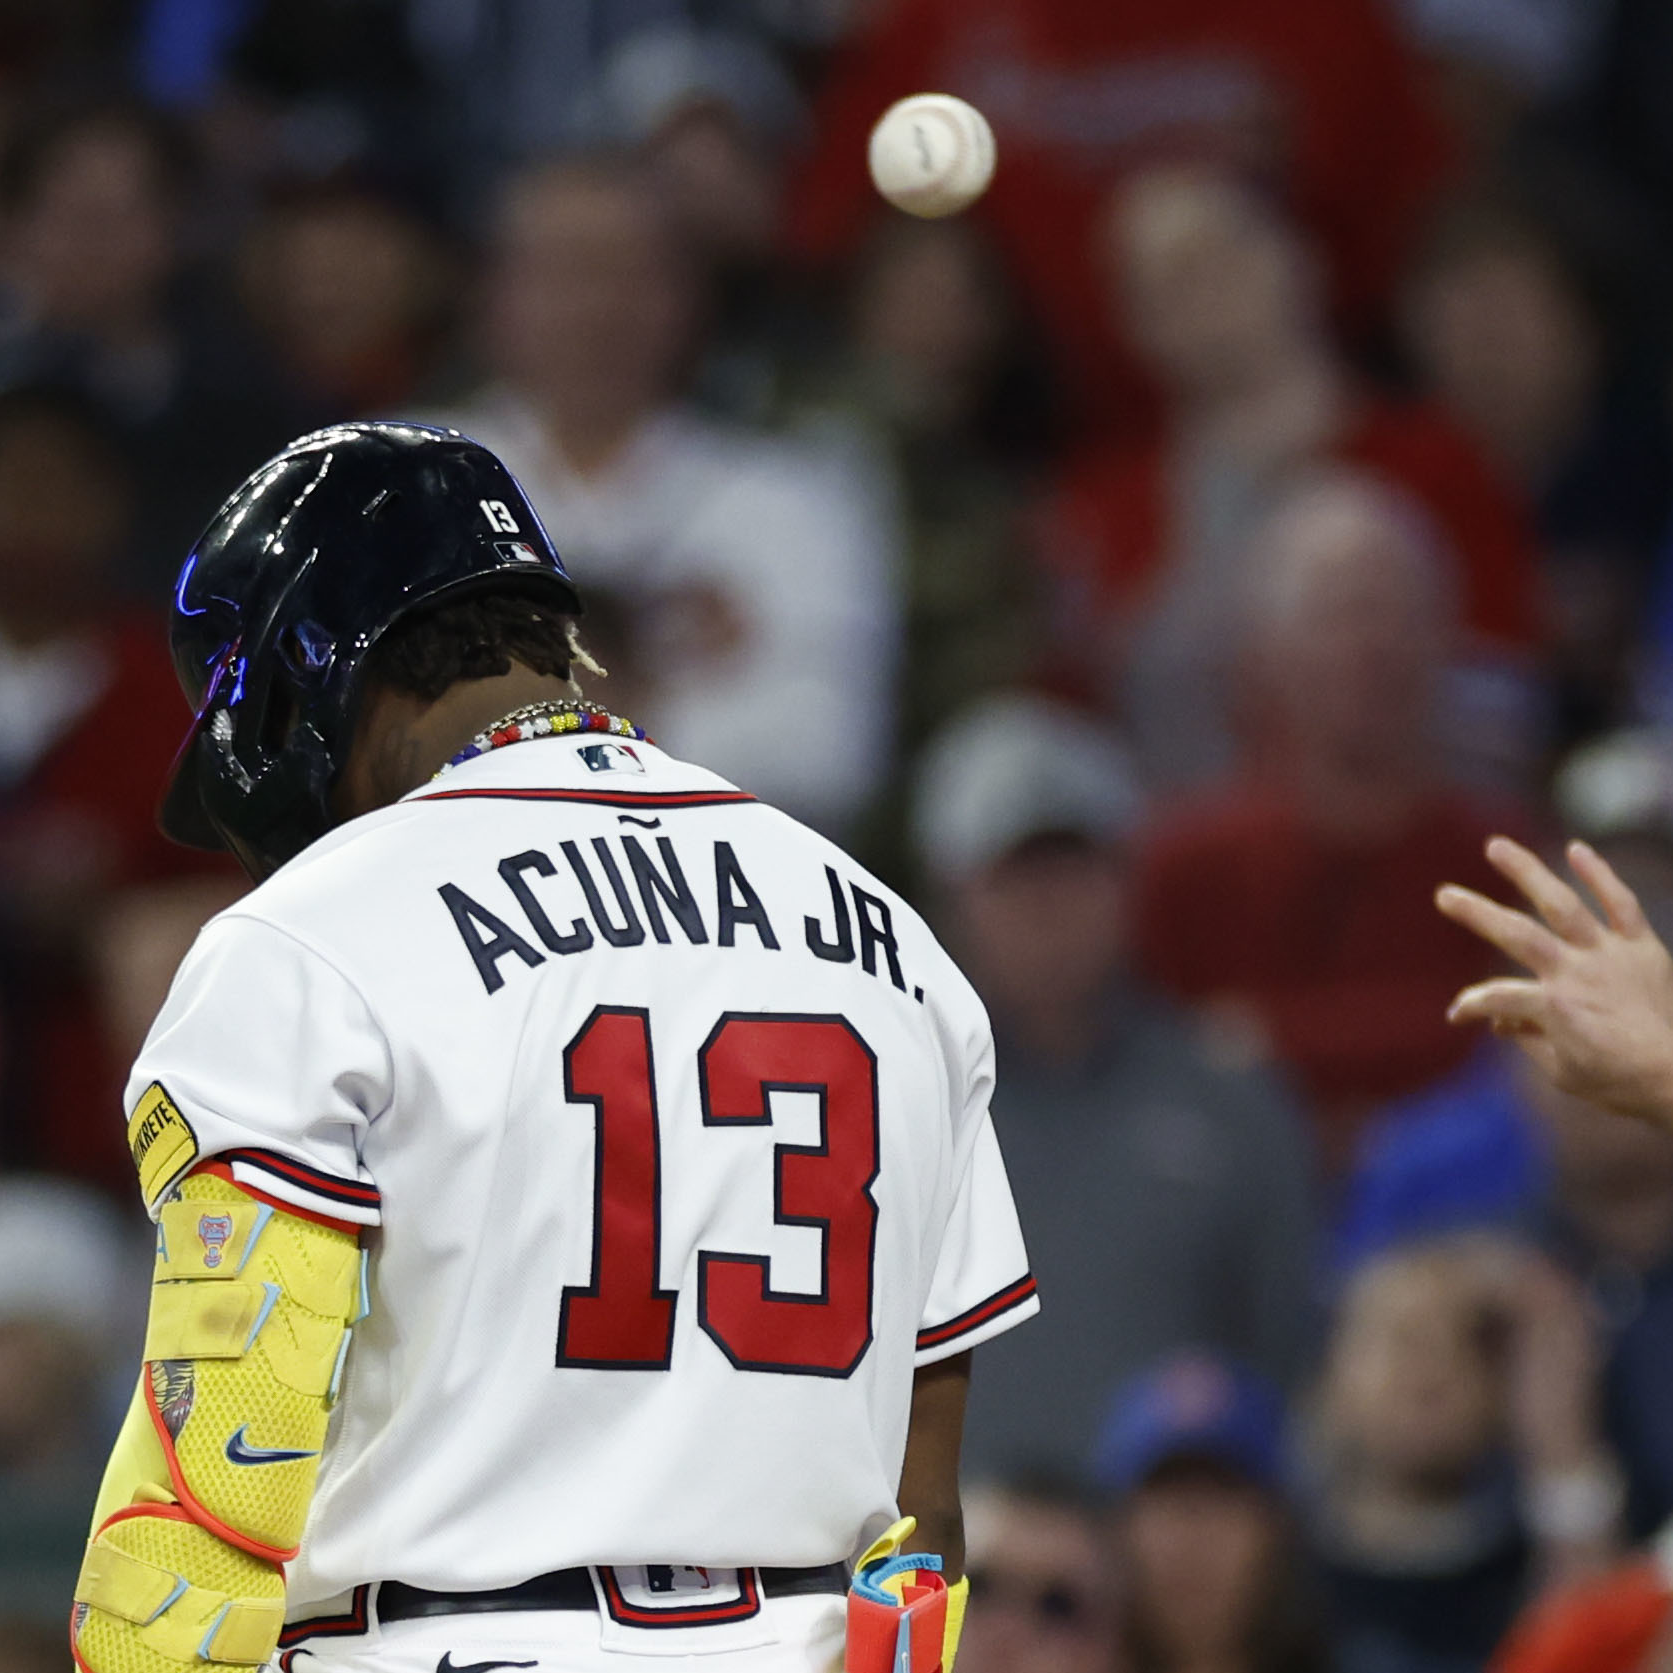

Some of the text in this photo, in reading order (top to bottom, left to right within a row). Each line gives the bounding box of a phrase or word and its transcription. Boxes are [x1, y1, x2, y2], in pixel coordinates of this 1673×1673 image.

[479, 499, 520, 534] 13
[436, 815, 925, 1005] ACUÑA JR.
[555, 1003, 881, 1380] 13
